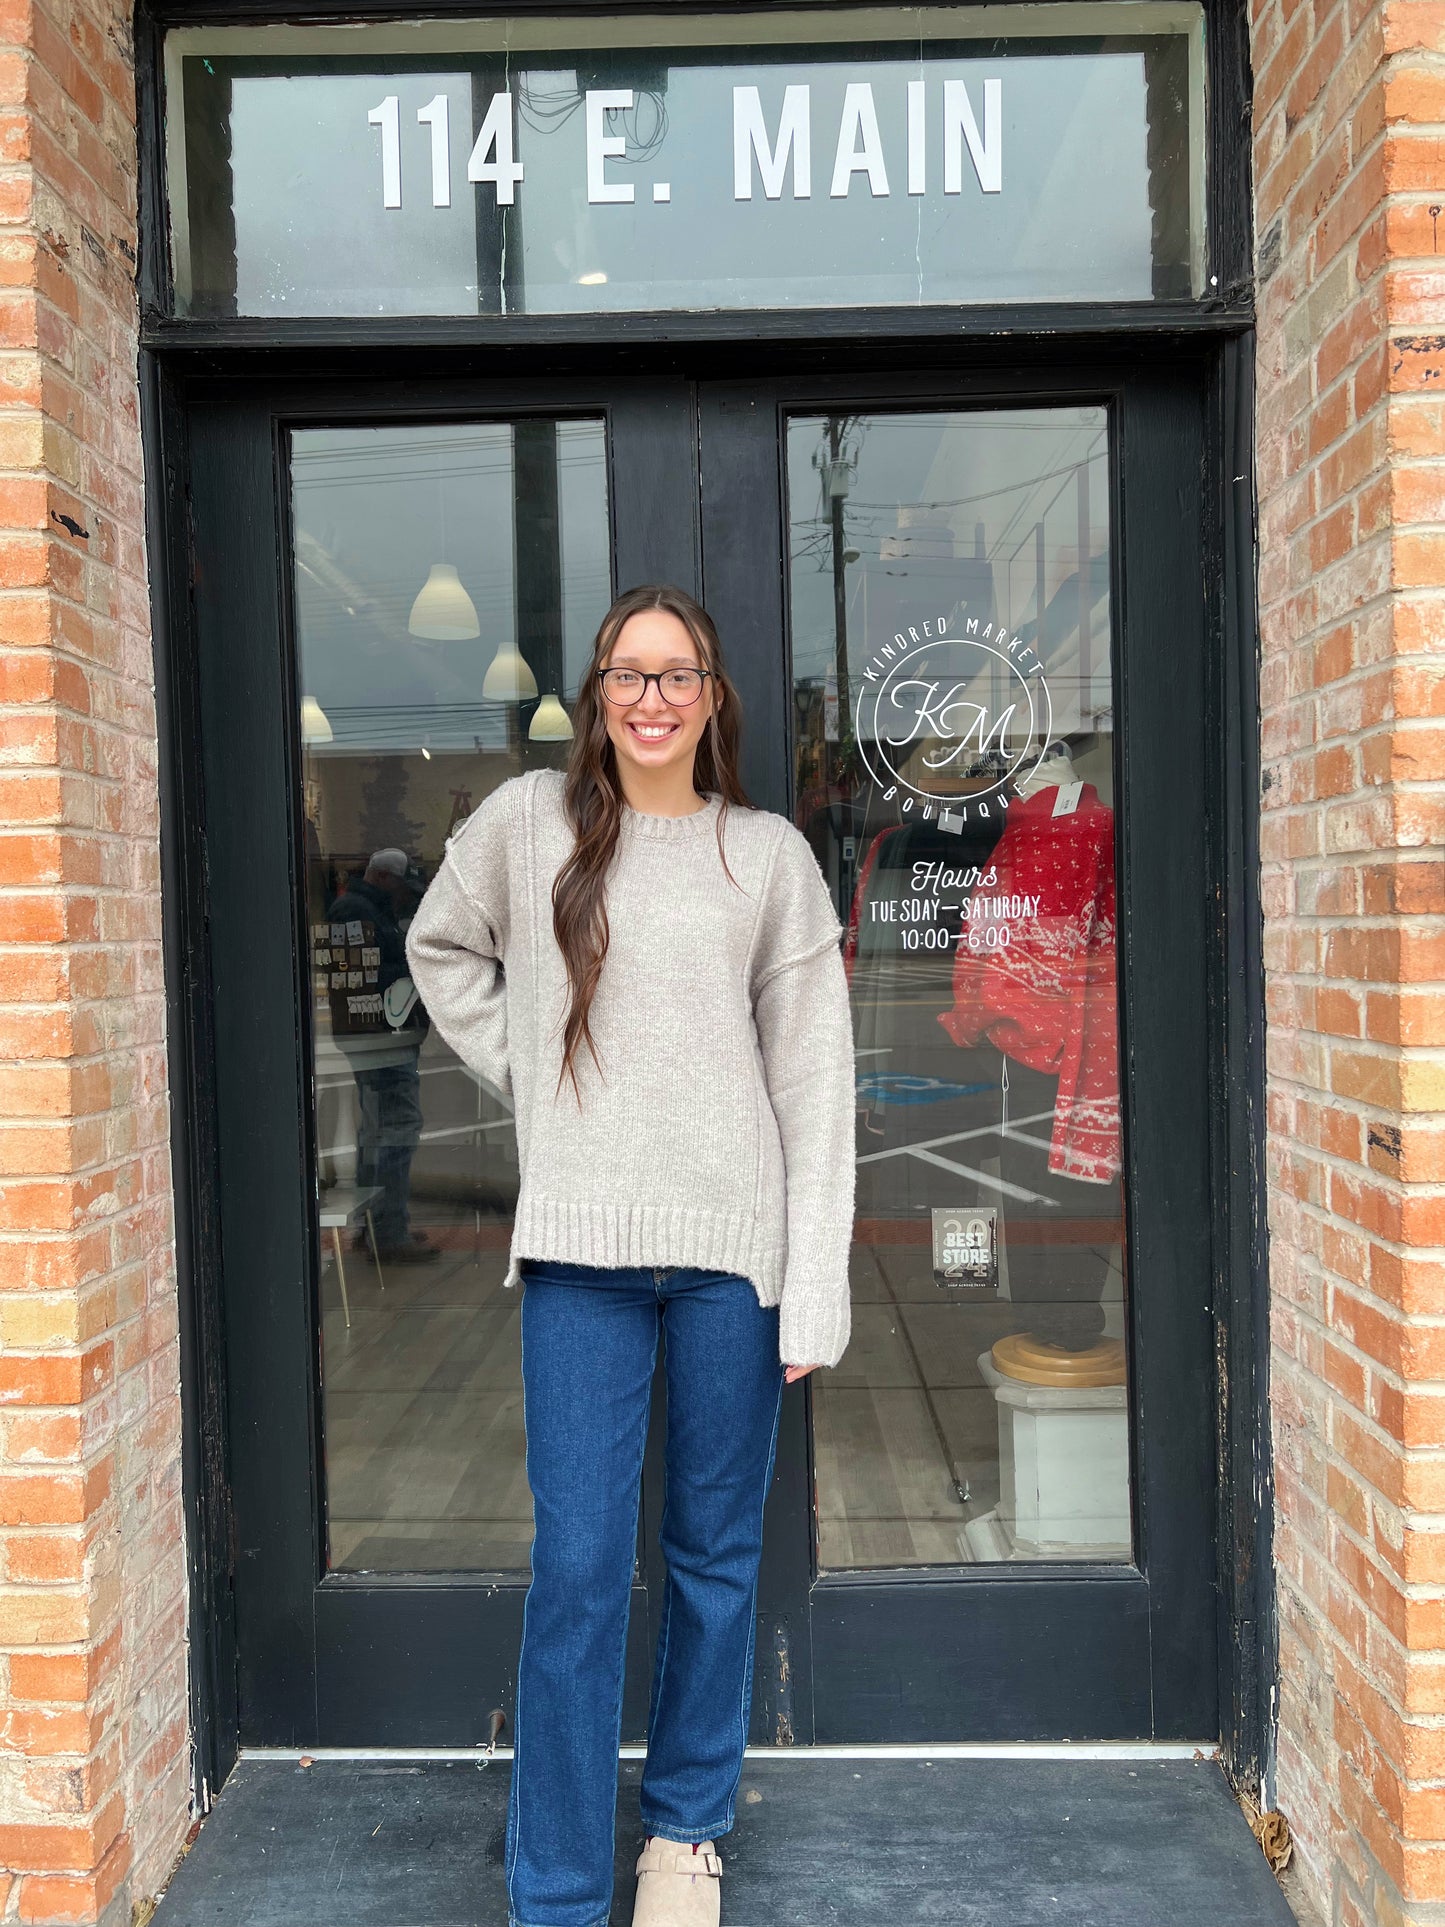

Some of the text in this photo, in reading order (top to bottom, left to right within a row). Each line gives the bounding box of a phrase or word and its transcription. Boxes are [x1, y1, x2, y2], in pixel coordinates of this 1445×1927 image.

[368, 79, 1001, 208] 114 E. MAIN
[863, 617, 1043, 682] KINDRED MARKET
[883, 781, 1026, 822] BOUTIQUE
[911, 861, 998, 895] Hours
[943, 1249, 989, 1264] STORE
[946, 1233, 984, 1247] BEST
